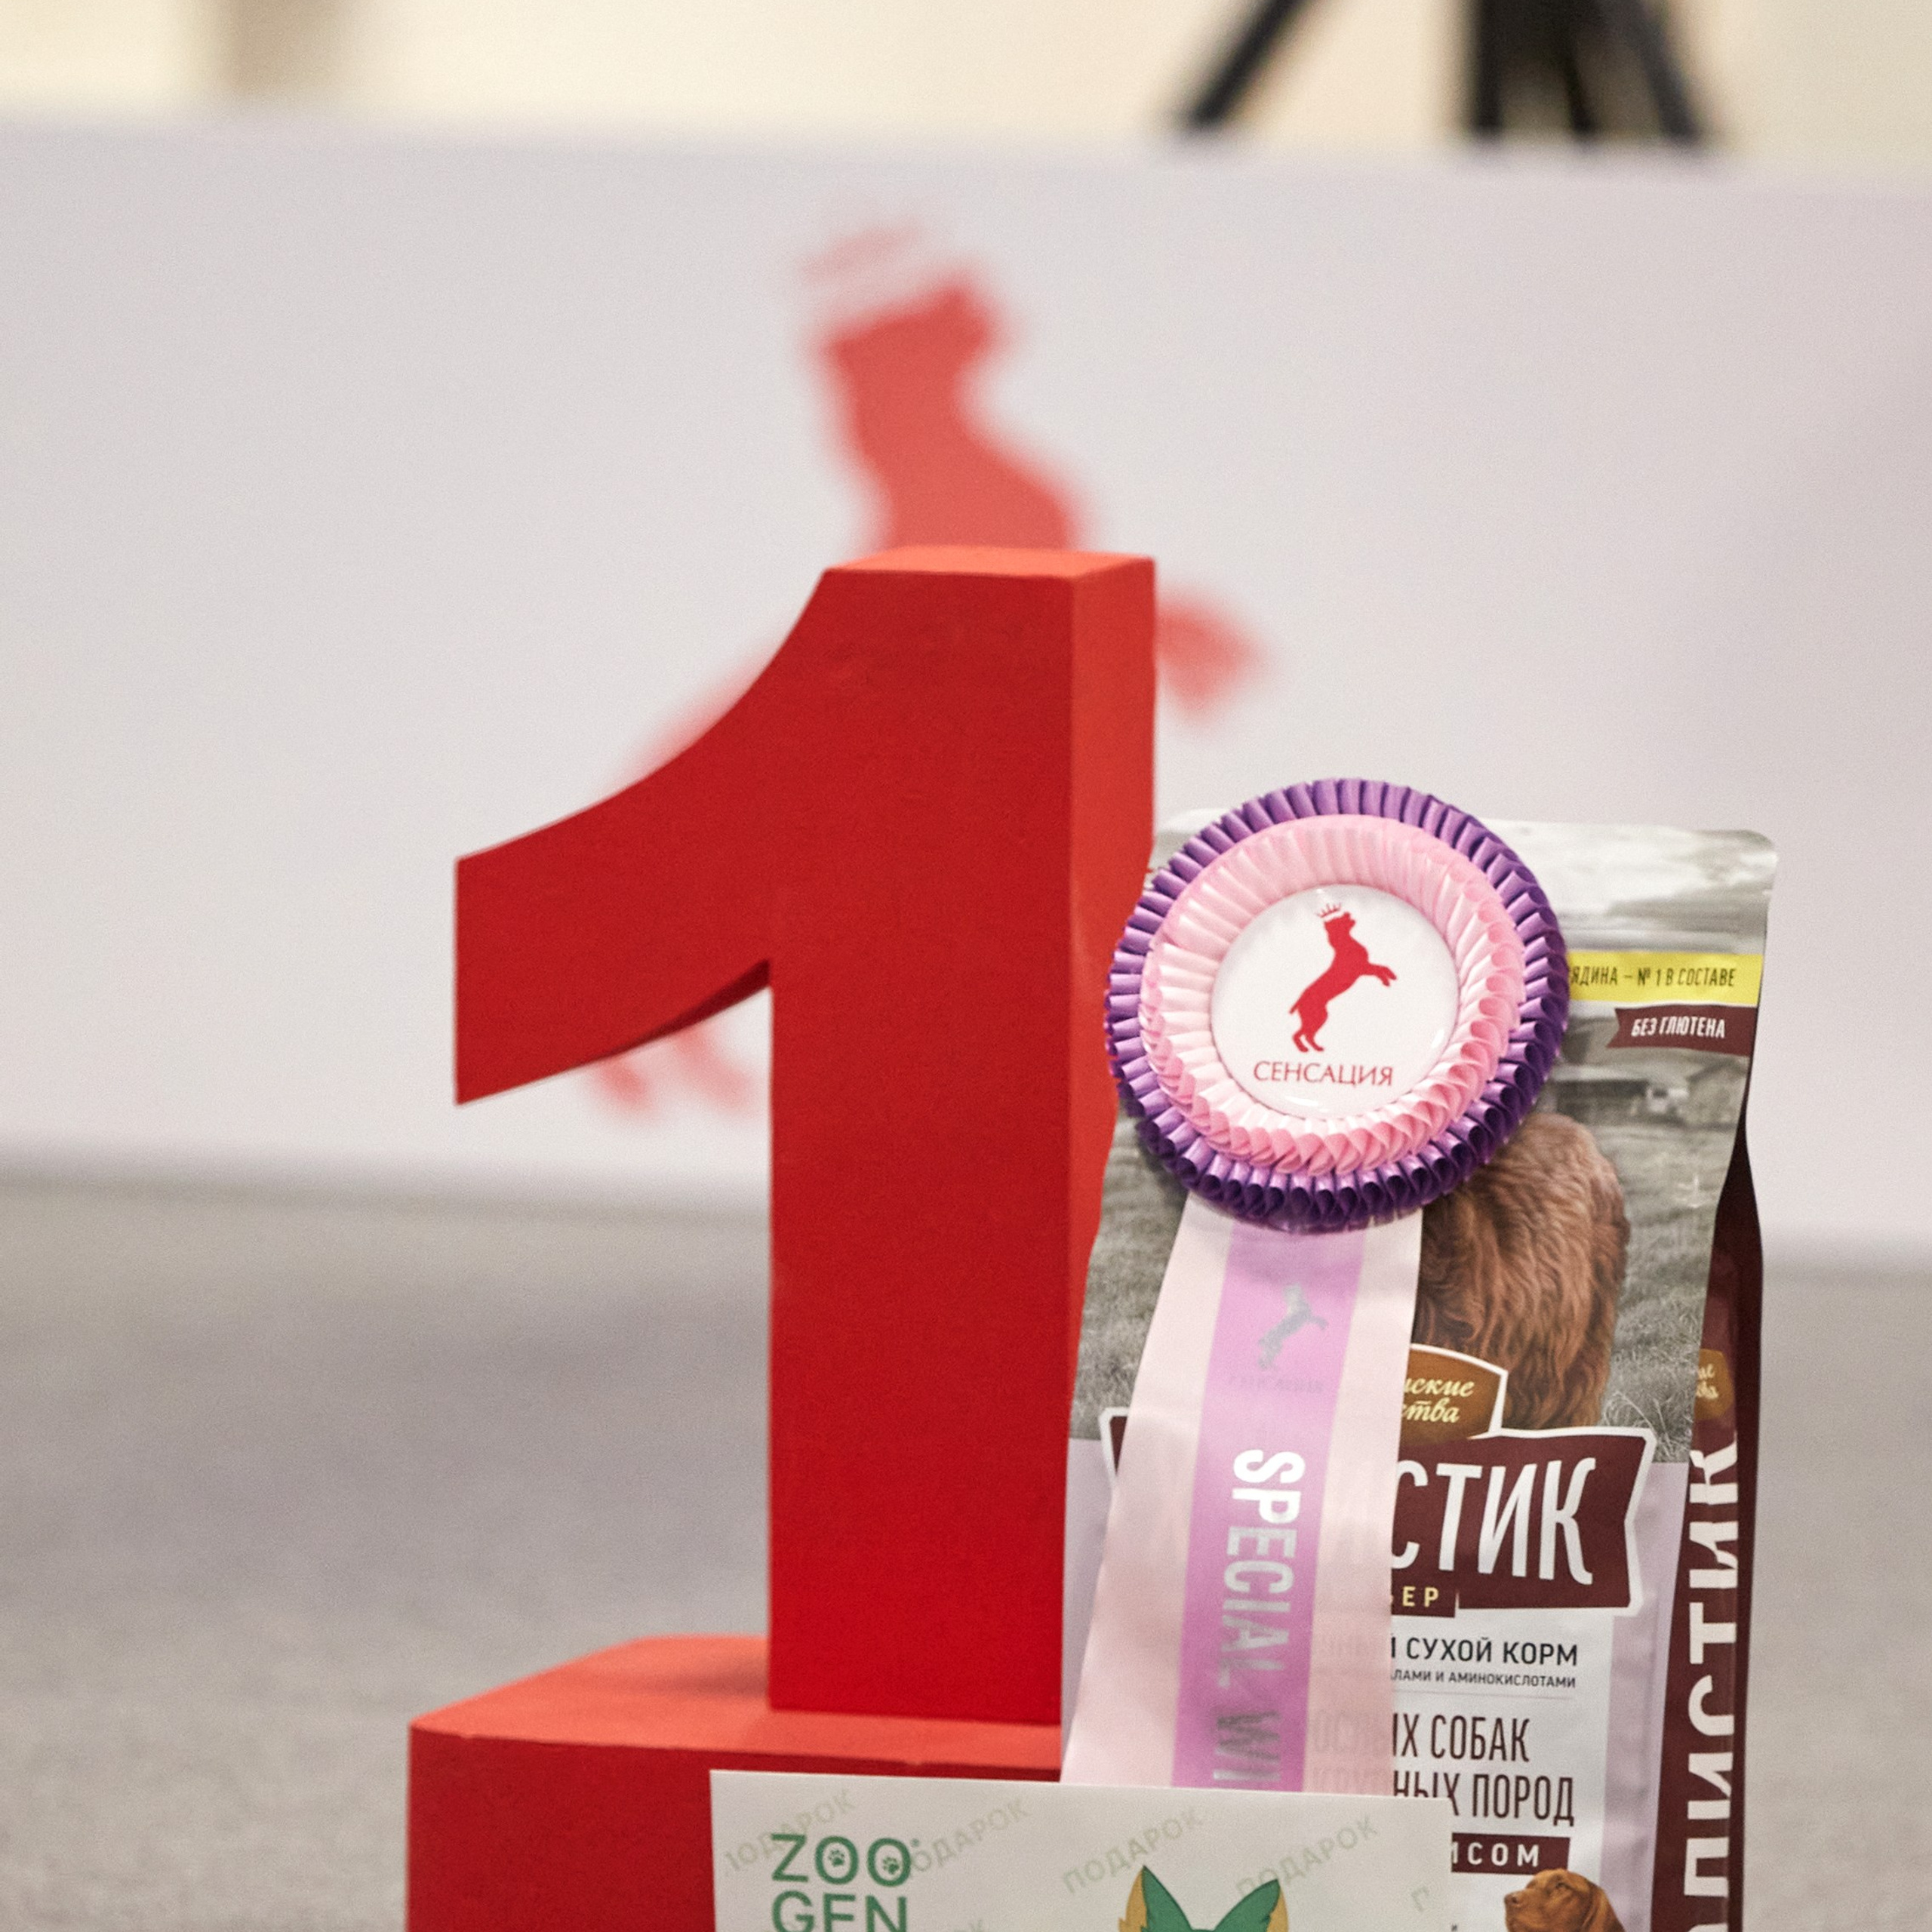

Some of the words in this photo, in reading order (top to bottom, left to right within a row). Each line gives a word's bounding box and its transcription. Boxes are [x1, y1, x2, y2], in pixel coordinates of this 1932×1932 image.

[1569, 965, 1618, 986] ЯДИНА
[1677, 968, 1736, 987] СОСТАВЕ
[1631, 1017, 1658, 1038] БЕЗ
[1659, 1015, 1726, 1038] ГЛЮТЕНА
[1253, 1060, 1394, 1089] СЕНСАЦИЯ
[1217, 1448, 1306, 1690] SPECIAL
[1391, 1586, 1440, 1608] ЕР
[1406, 1636, 1493, 1663] СУХОЙ
[1503, 1641, 1579, 1666] КОРМ
[1391, 1668, 1432, 1682] ЛАМИ
[1447, 1671, 1577, 1689] АМИНОКИСЛОТАМИ
[1430, 1714, 1531, 1762] СОБАК
[1472, 1774, 1574, 1827] ПОРОД
[908, 1796, 1032, 1873] ОДАРОК
[1063, 1805, 1204, 1894] ПОДАРОК
[771, 1832, 912, 1887] ZOO
